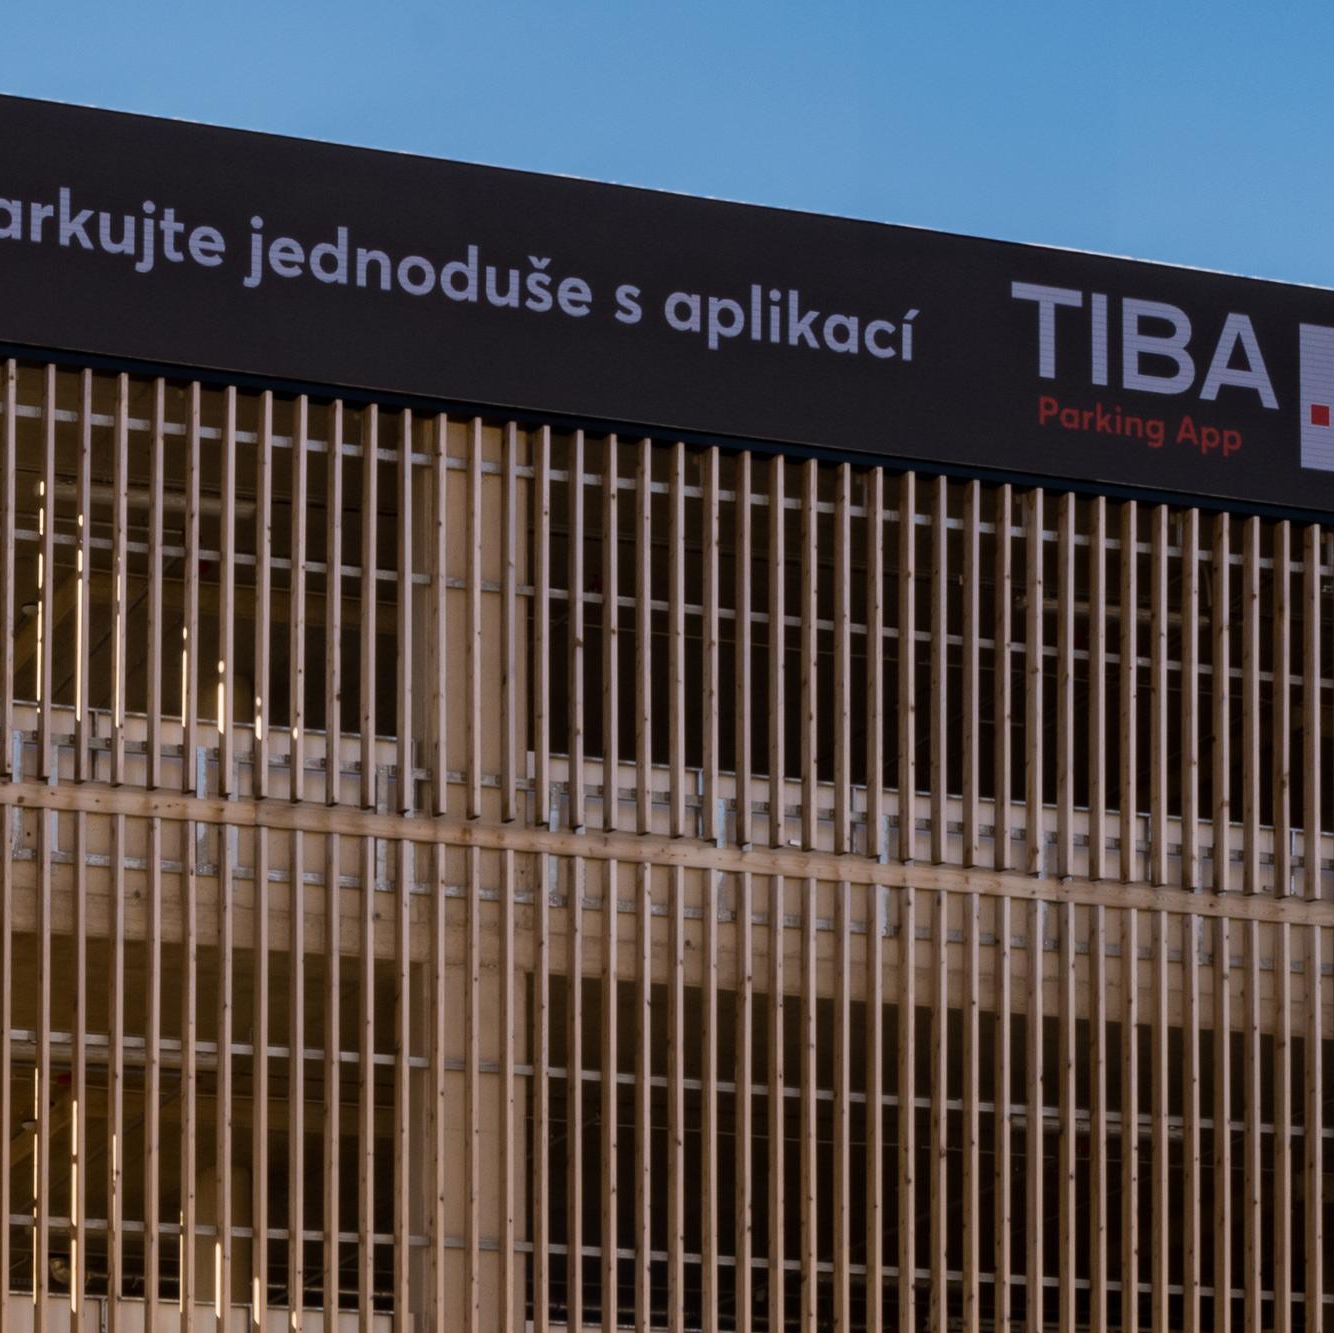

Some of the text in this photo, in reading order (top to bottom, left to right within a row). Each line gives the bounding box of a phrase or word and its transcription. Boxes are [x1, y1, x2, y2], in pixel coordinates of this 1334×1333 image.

[242, 214, 593, 318] jednoduše
[613, 281, 642, 325] s
[664, 284, 920, 361] aplikací
[1010, 280, 1280, 411] TIBA
[1038, 396, 1244, 456] Parking App
